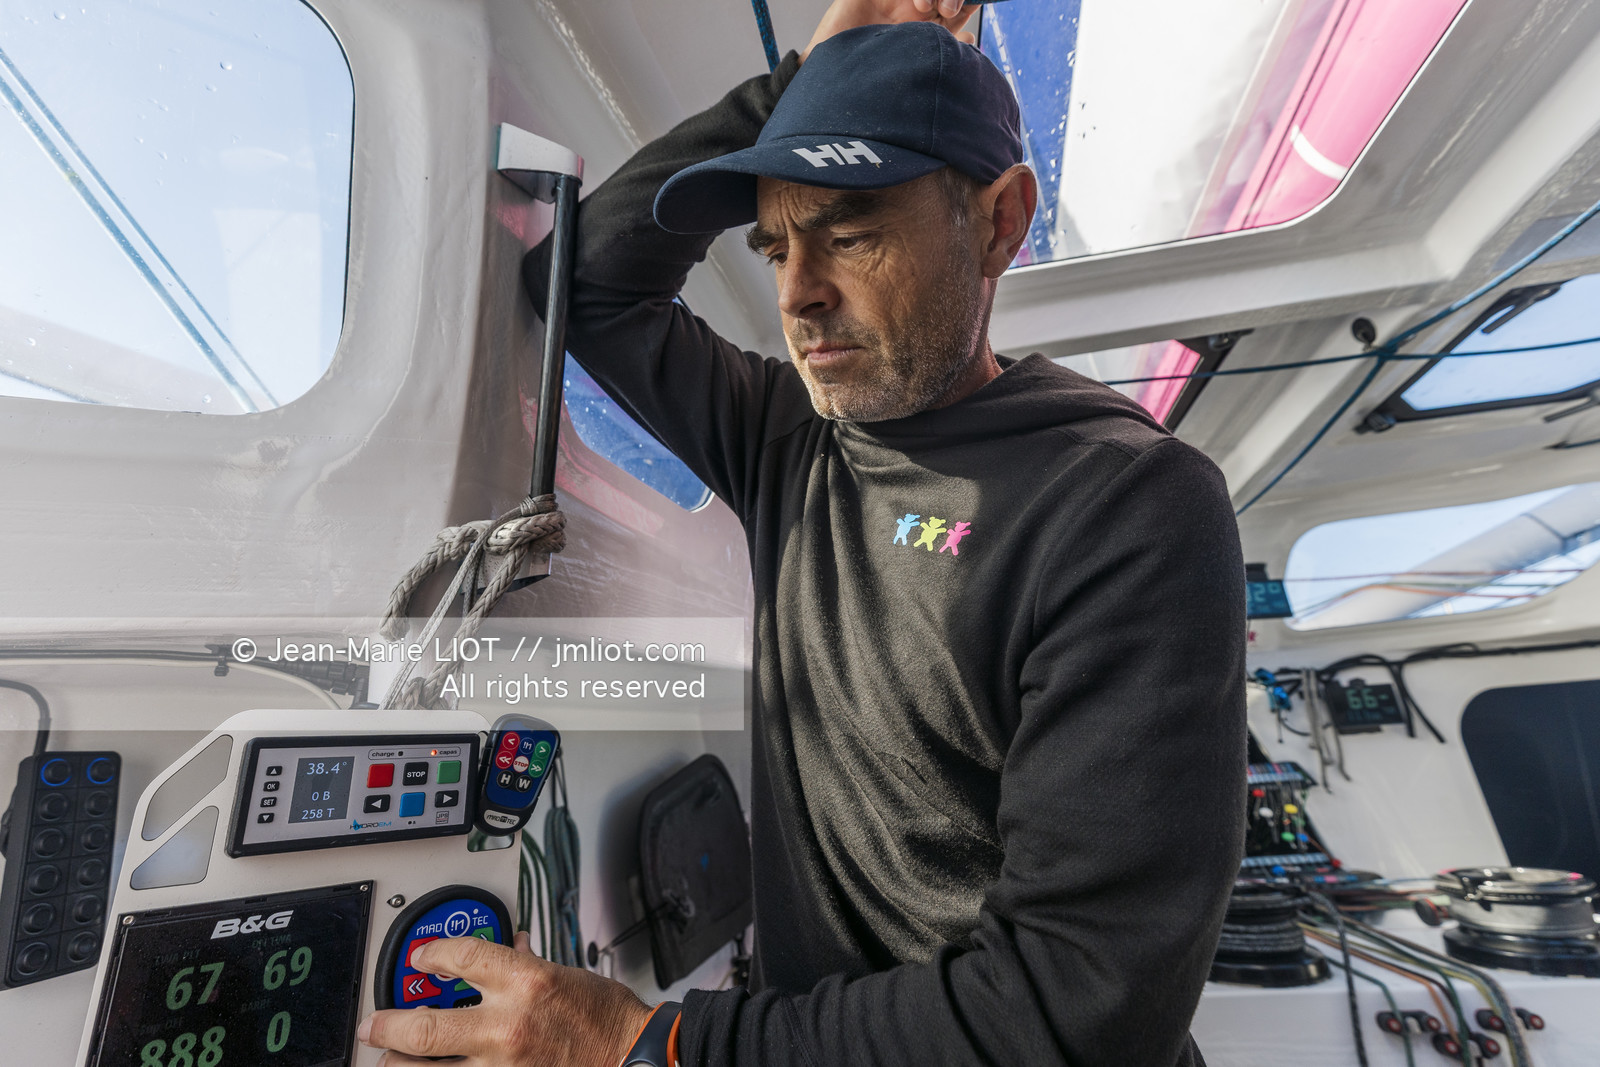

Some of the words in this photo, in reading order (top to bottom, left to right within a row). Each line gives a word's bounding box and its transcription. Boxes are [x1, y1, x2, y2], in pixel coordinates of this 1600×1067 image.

[792, 141, 883, 168] HH
[513, 760, 529, 768] STOP
[500, 773, 511, 785] H
[519, 778, 531, 789] W
[263, 798, 275, 806] SET
[301, 808, 323, 820] 258
[326, 807, 335, 818] T
[210, 910, 295, 940] B&G
[472, 915, 489, 927] TEC
[262, 946, 313, 991] 69
[165, 961, 225, 1011] 67
[266, 1011, 292, 1053] 0
[139, 1025, 227, 1067] 888
